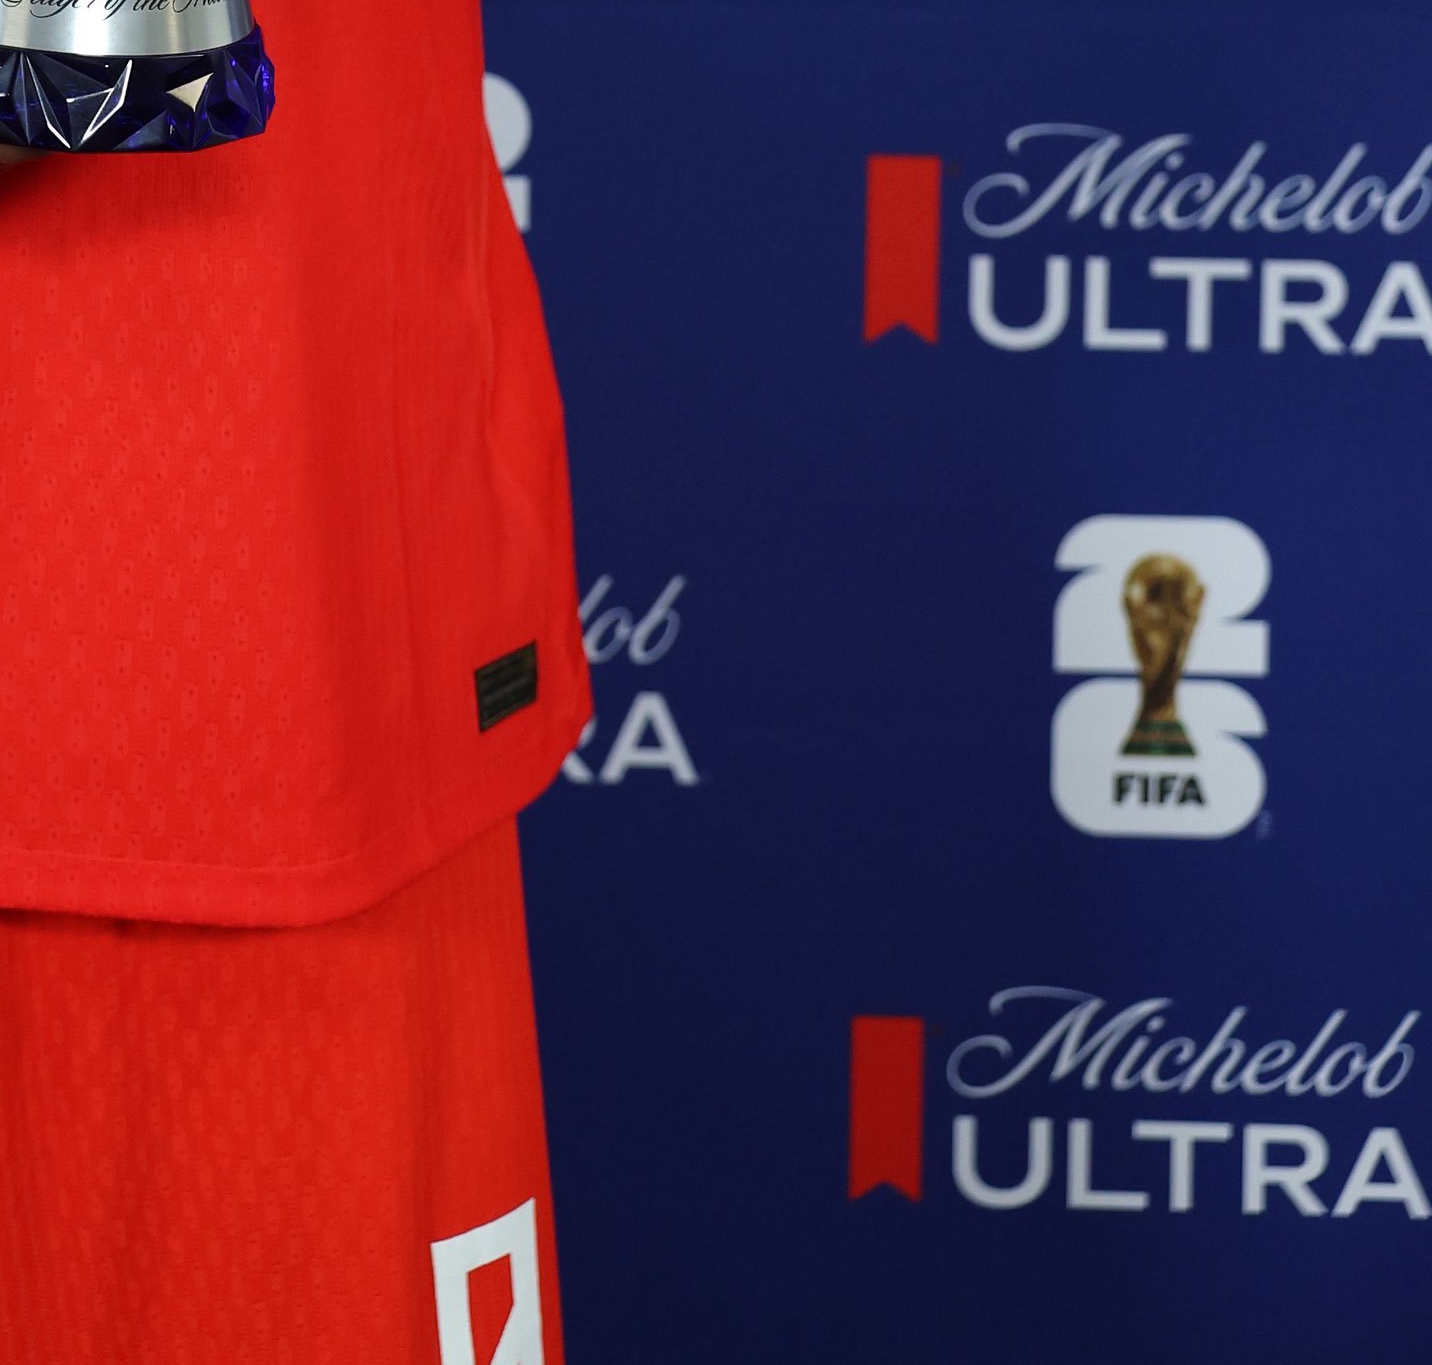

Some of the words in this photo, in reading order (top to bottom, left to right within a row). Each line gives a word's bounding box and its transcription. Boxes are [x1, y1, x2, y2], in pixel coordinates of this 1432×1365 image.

[969, 254, 1432, 355] ULTRA
[1112, 772, 1207, 807] FIFA
[947, 985, 1421, 1098] Michelob
[953, 1115, 1432, 1221] ULTRA
